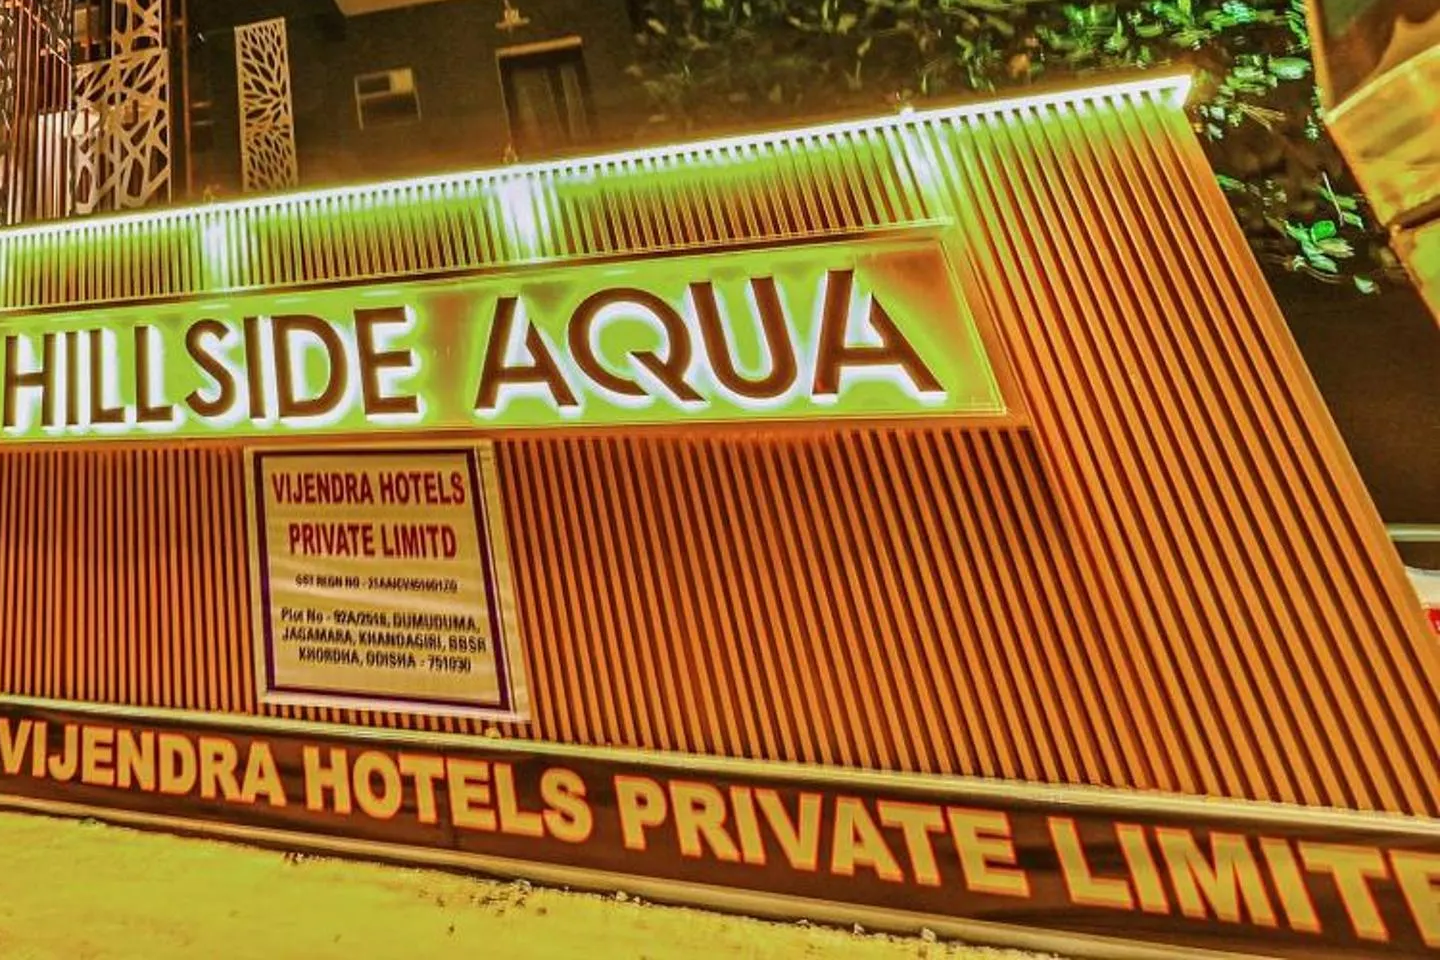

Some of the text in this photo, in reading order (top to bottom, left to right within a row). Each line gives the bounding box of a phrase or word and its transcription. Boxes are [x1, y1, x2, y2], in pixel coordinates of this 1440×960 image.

[0, 267, 948, 430] HILLSIDE AQUA
[271, 471, 466, 506] VIJENDRA HOTELS
[288, 523, 457, 559] PRIVATE LIMITD
[306, 609, 323, 624] No
[302, 745, 595, 843] HOTELS
[614, 774, 1032, 898] PRIVATE
